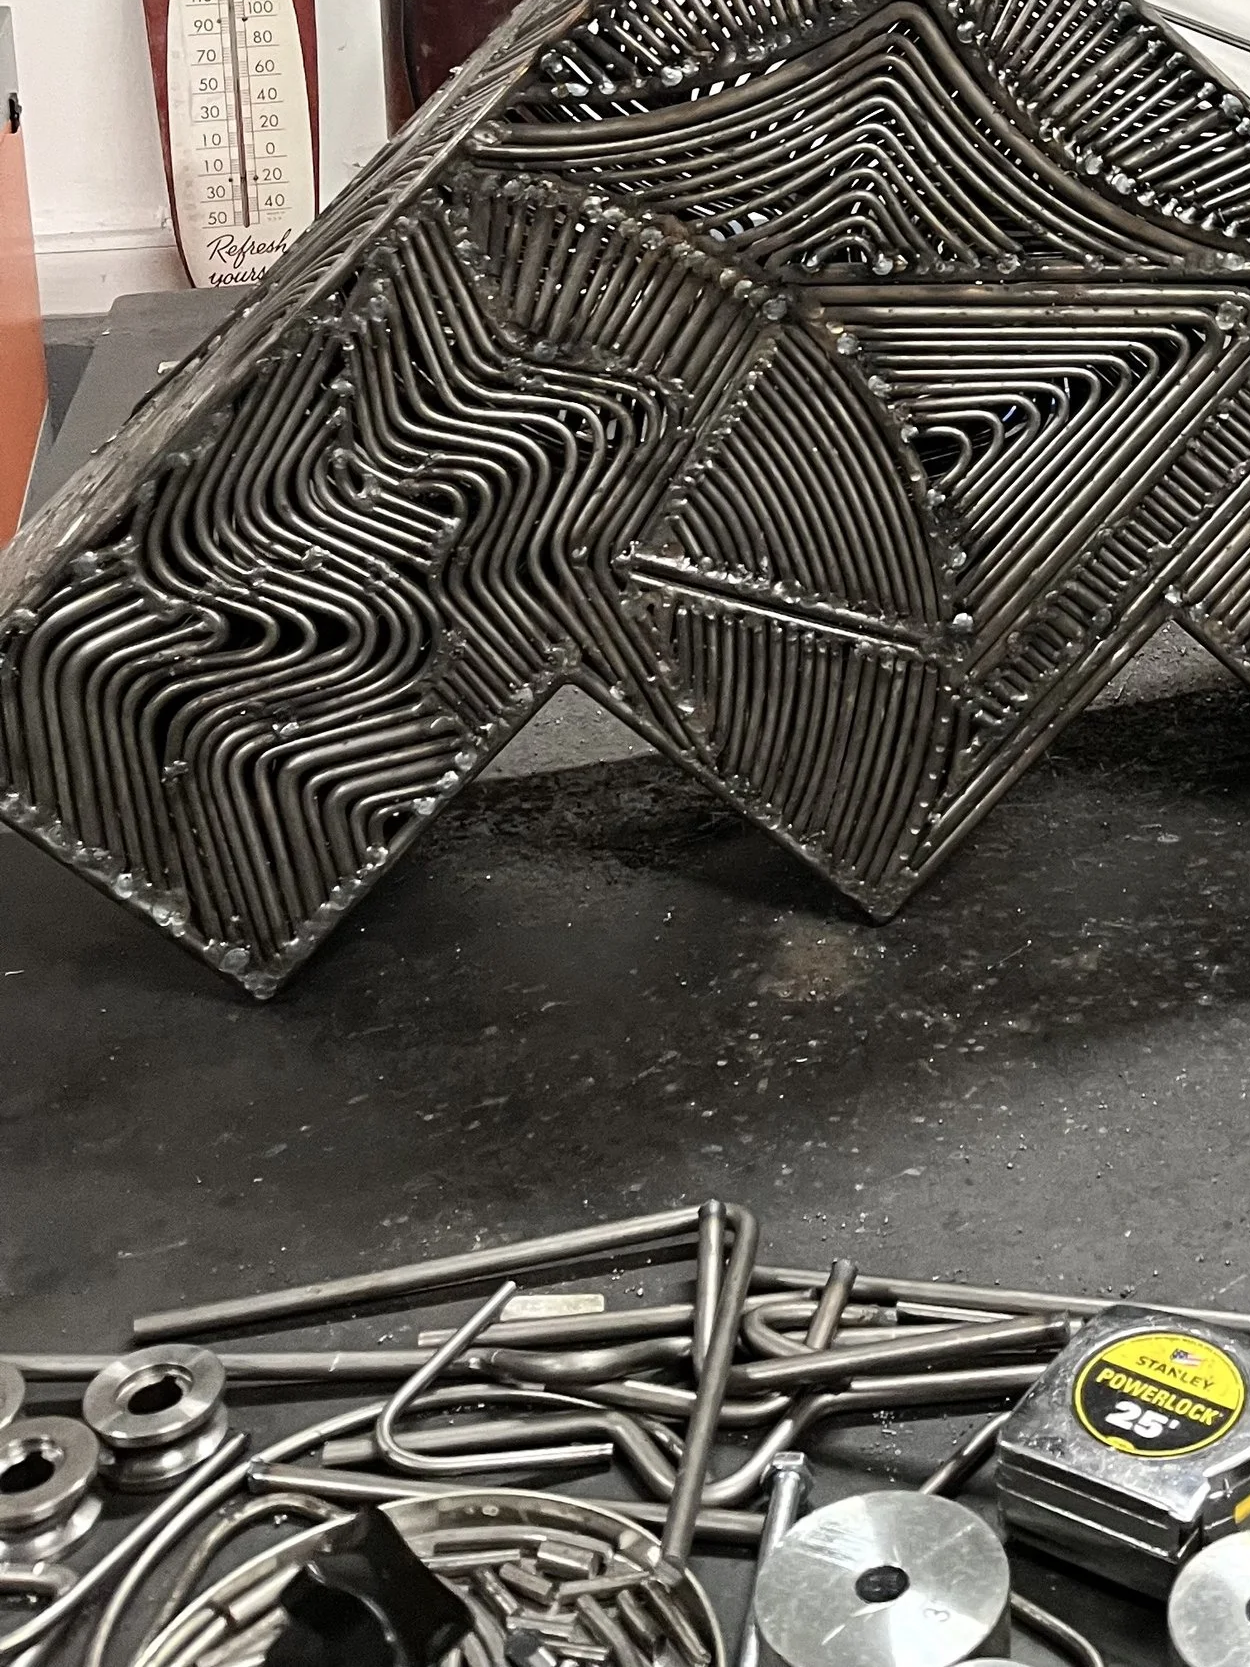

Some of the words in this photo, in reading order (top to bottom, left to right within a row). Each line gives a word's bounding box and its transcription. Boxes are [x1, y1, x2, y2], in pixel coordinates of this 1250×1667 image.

[248, 0, 273, 14] 100
[194, 18, 214, 32] 90
[253, 30, 272, 44] 80
[196, 49, 216, 62] 70
[255, 59, 275, 73] 60
[199, 77, 218, 91] 50
[257, 87, 277, 101] 40
[200, 105, 220, 119] 30
[260, 114, 279, 128] 20
[202, 133, 221, 147] 10
[265, 142, 275, 155] 0
[204, 159, 223, 172] 10
[262, 167, 282, 181] 20
[206, 185, 226, 199] 30
[264, 193, 285, 207] 40
[208, 211, 227, 225] 50
[207, 228, 292, 269] Refresh
[208, 266, 266, 288] yours
[1136, 1355, 1214, 1390] STANLEY
[1096, 1368, 1220, 1425] POWERLOCK
[1105, 1401, 1180, 1438] 25'
